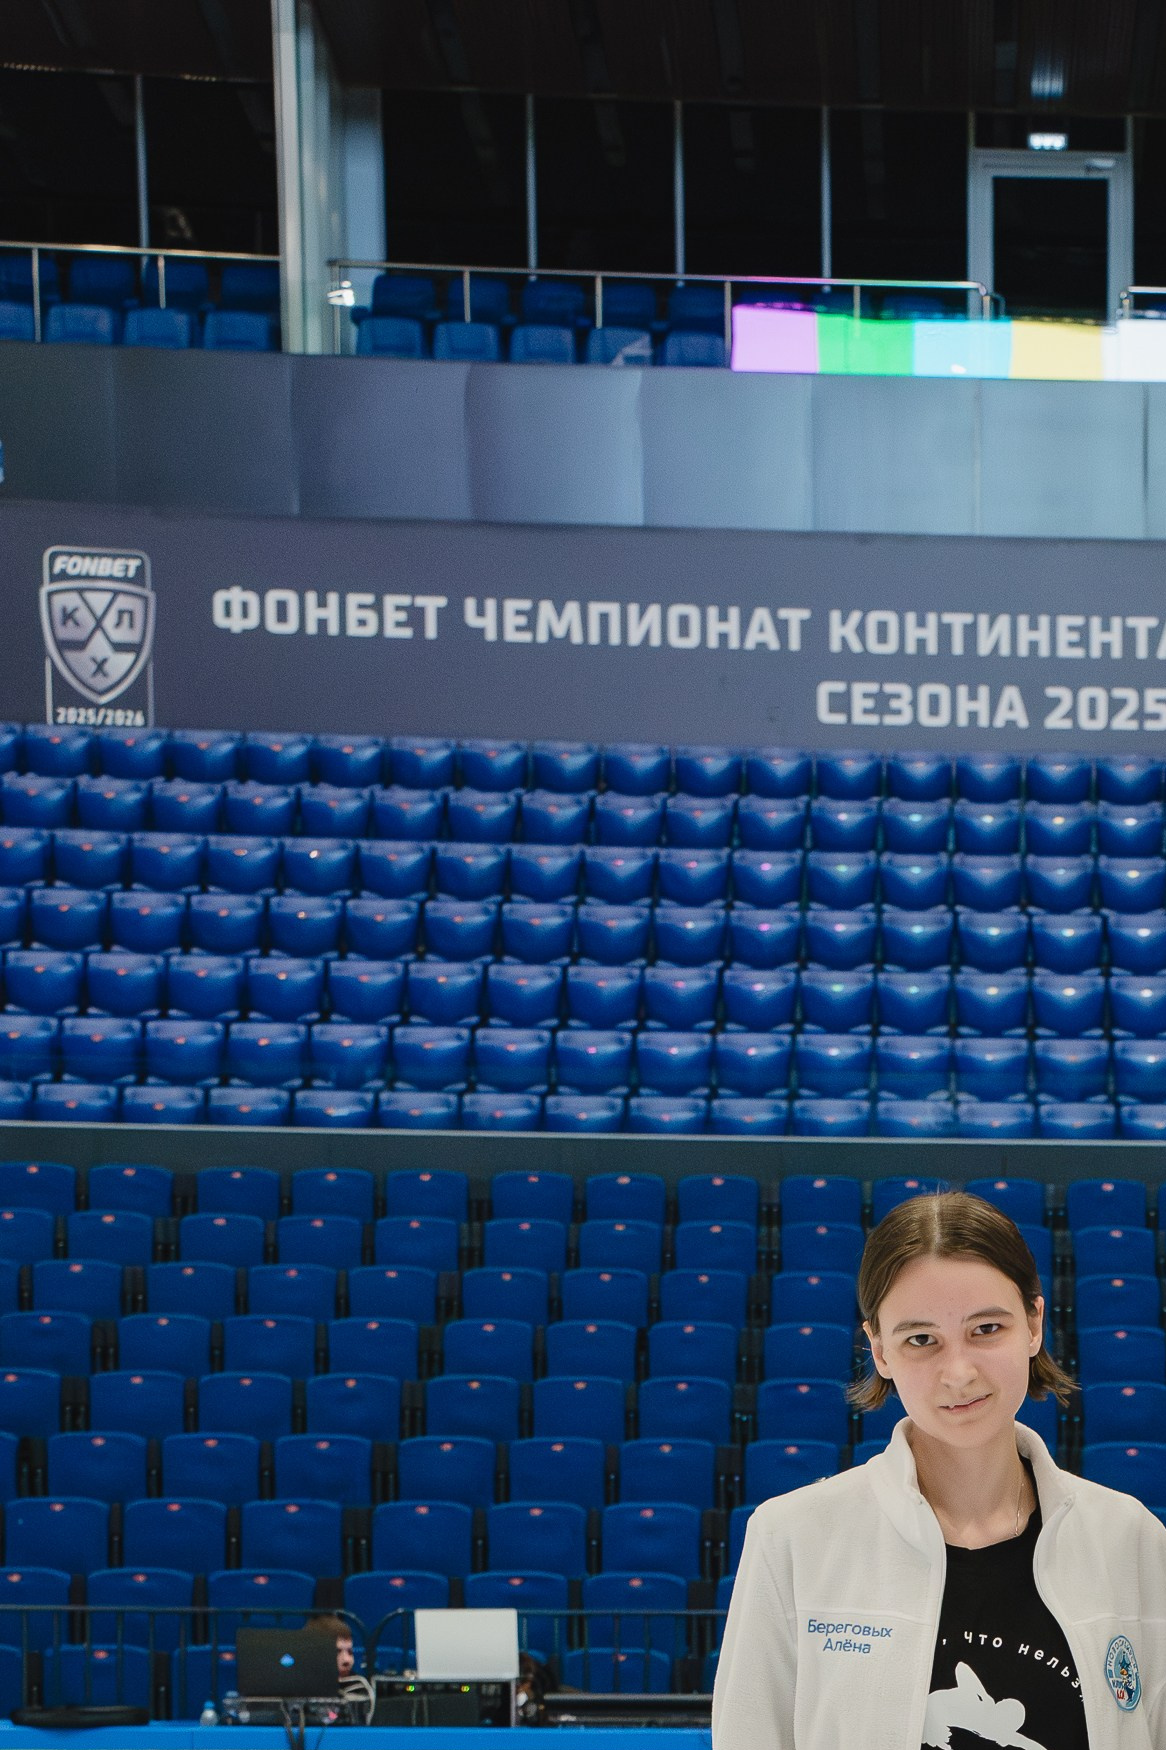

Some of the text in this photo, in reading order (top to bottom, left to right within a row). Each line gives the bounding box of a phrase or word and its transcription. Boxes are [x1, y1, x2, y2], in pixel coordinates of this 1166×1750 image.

[53, 555, 142, 578] FONBET
[212, 585, 448, 641] ФОНБЕТ
[464, 597, 812, 652] ЧЕМПИОНАТ
[56, 706, 146, 727] 2025/2026
[816, 681, 1030, 730] СЕЗОНА
[807, 1618, 893, 1638] Береговых
[823, 1637, 871, 1655] Алёна
[964, 1630, 1003, 1648] что
[1018, 1643, 1083, 1702] нельз
